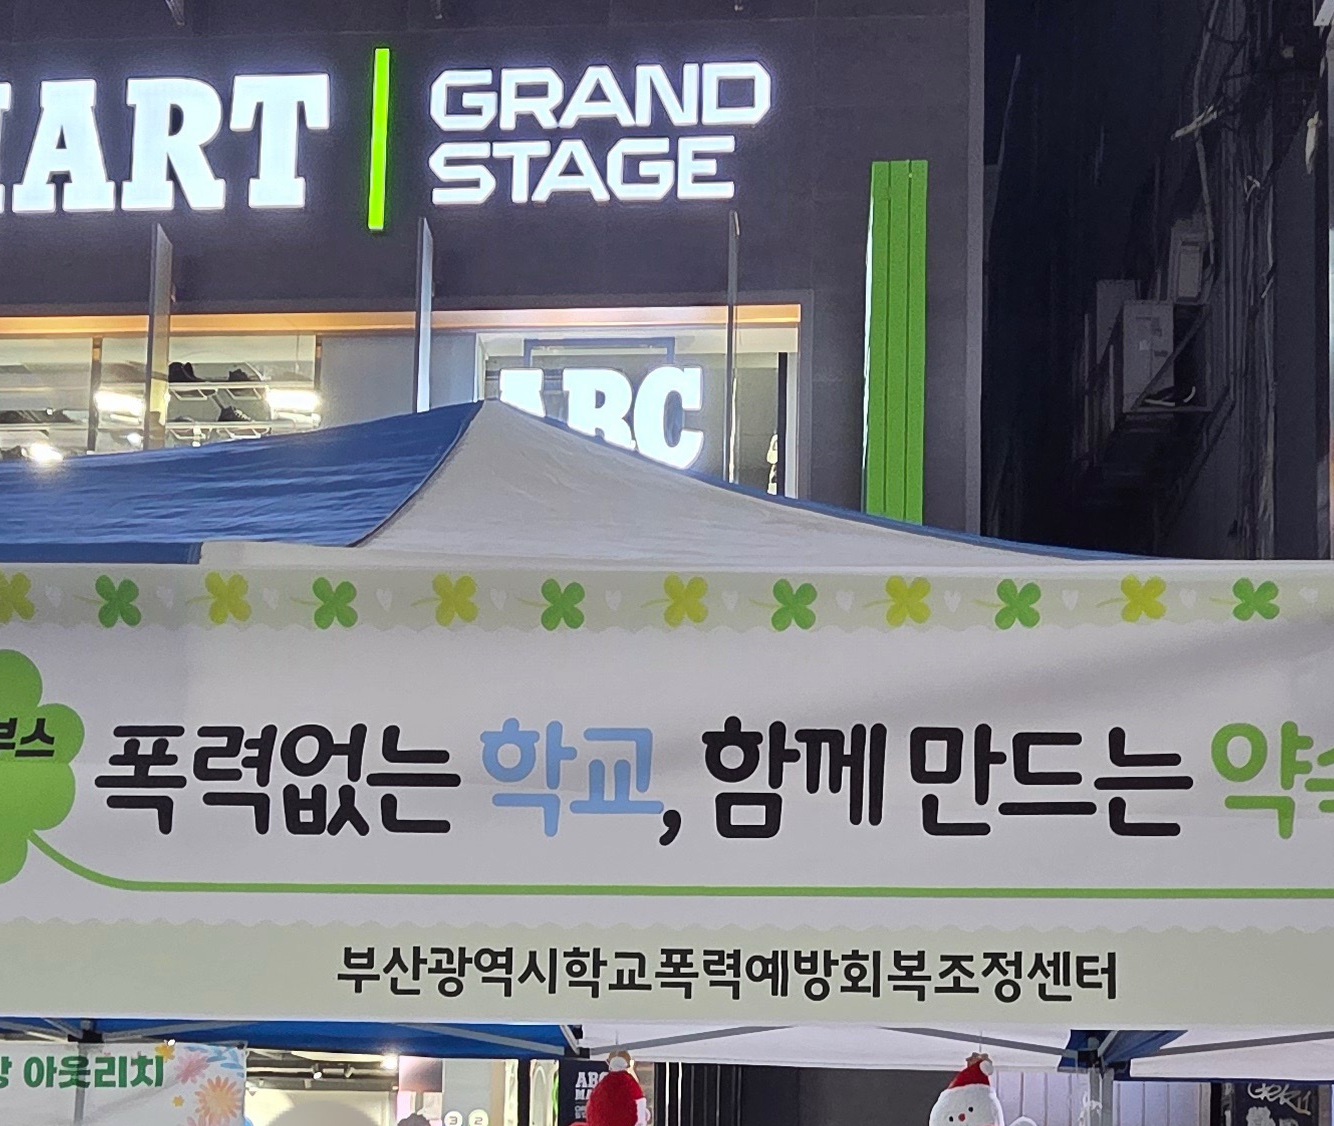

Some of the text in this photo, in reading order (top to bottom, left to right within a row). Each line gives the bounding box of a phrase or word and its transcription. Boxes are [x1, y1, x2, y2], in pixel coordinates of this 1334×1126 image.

[430, 61, 771, 131] GRAND
[428, 136, 735, 205] STAGE
[95, 724, 461, 836] 폭력없는
[482, 717, 681, 845] 학교,
[703, 716, 885, 839] 함께
[909, 722, 1193, 838] 만드는
[336, 945, 1119, 1003] 부산광역시학교폭력예방회복조정센터
[23, 1055, 165, 1089] 아웃리치
